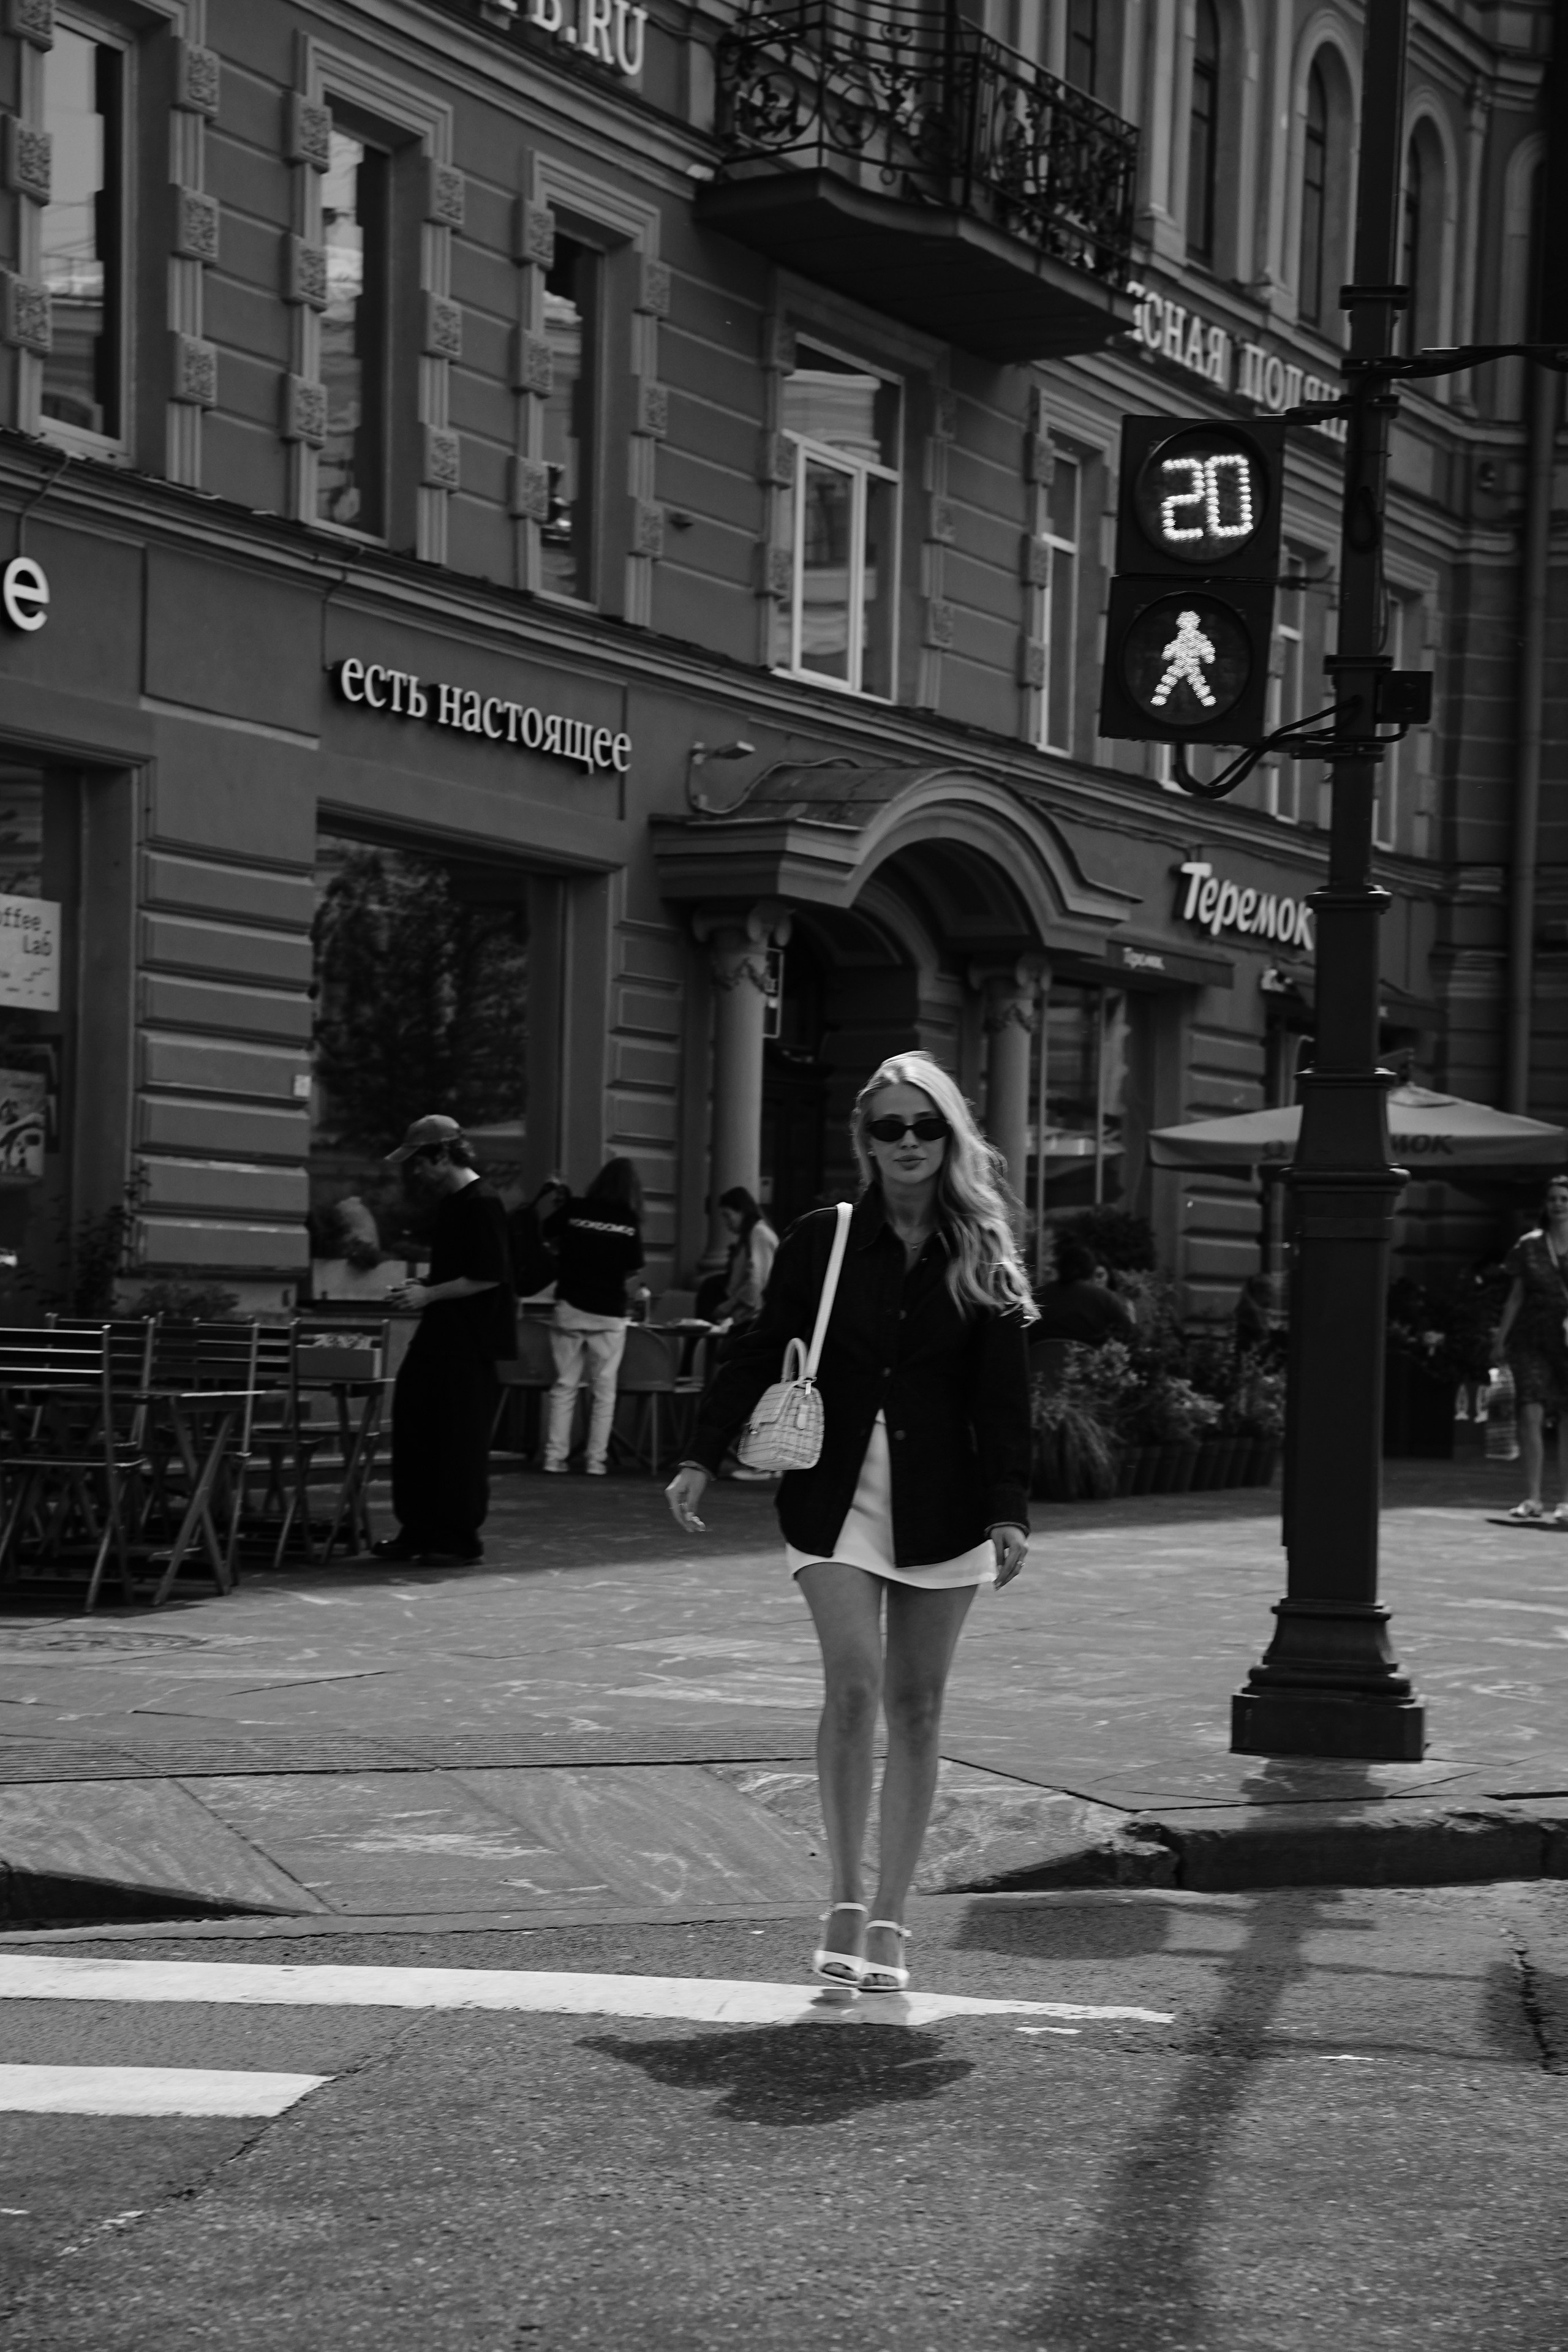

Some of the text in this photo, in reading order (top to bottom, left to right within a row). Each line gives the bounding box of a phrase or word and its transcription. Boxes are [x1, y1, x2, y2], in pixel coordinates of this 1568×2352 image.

[1161, 454, 1254, 542] 20
[341, 658, 632, 774] есть настоящее
[1180, 862, 1315, 951] Теремок
